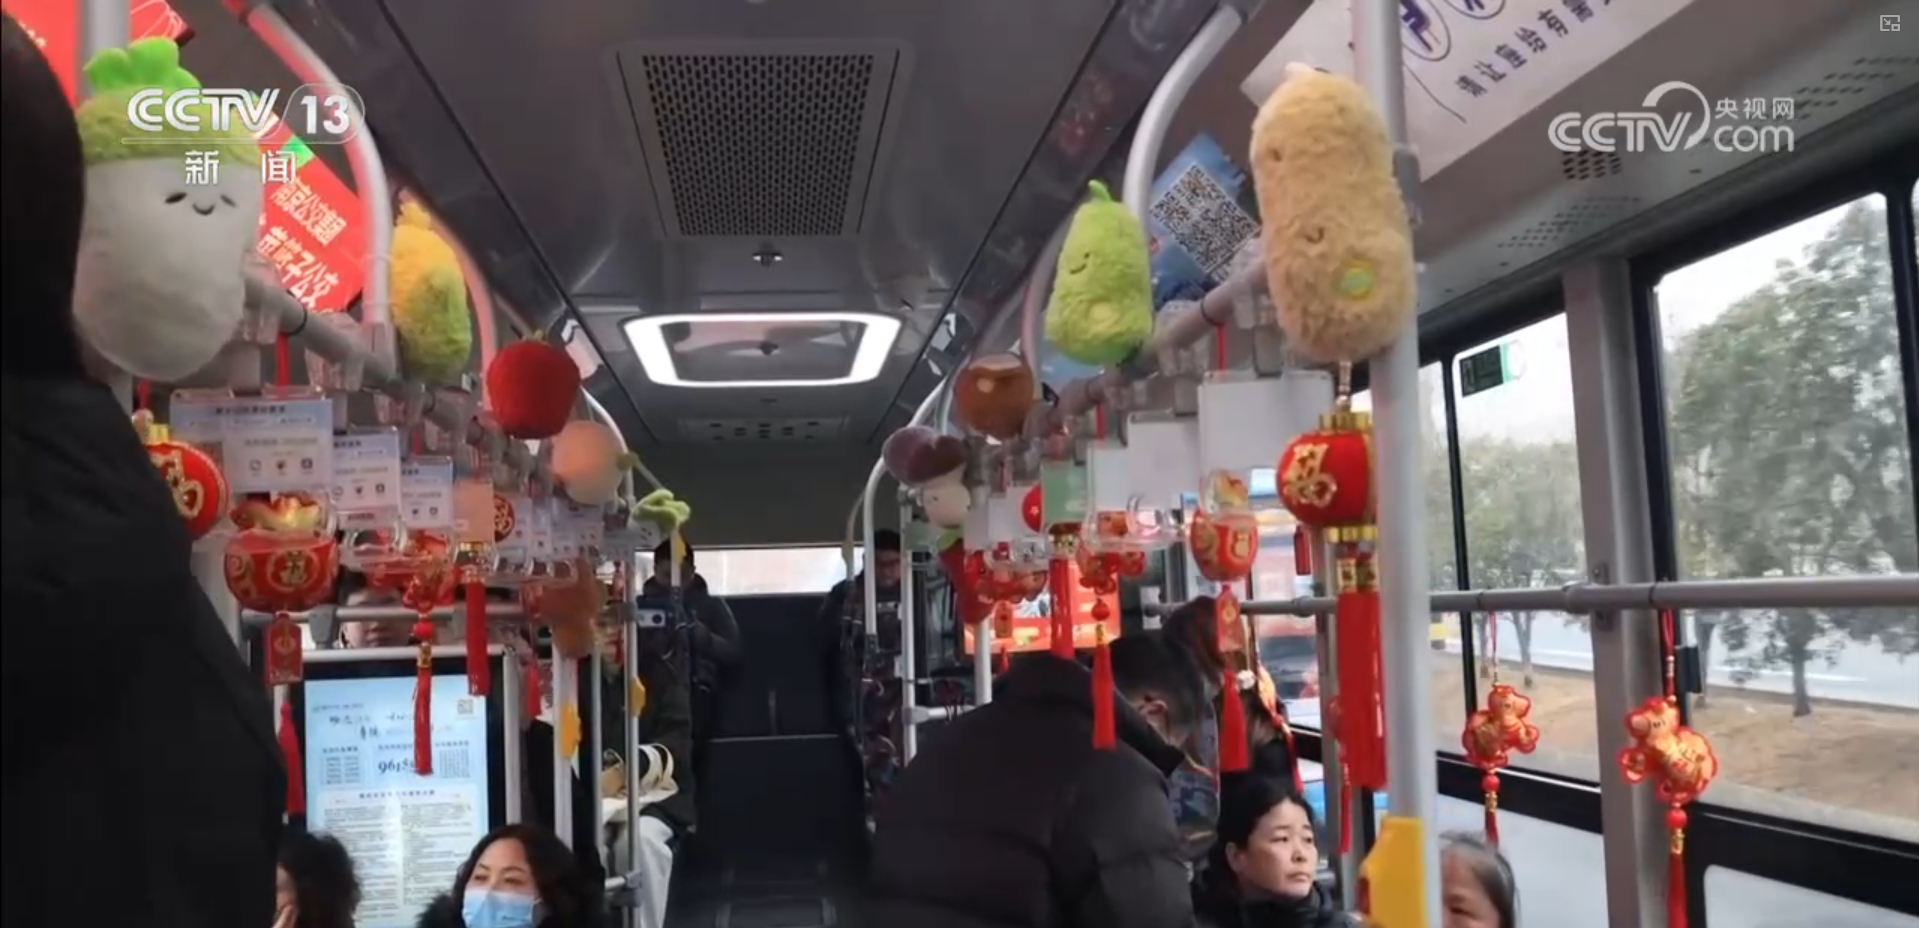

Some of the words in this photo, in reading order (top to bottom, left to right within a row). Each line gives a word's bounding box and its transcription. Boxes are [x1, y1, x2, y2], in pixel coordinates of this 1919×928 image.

[269, 177, 347, 246] 南京公交集团
